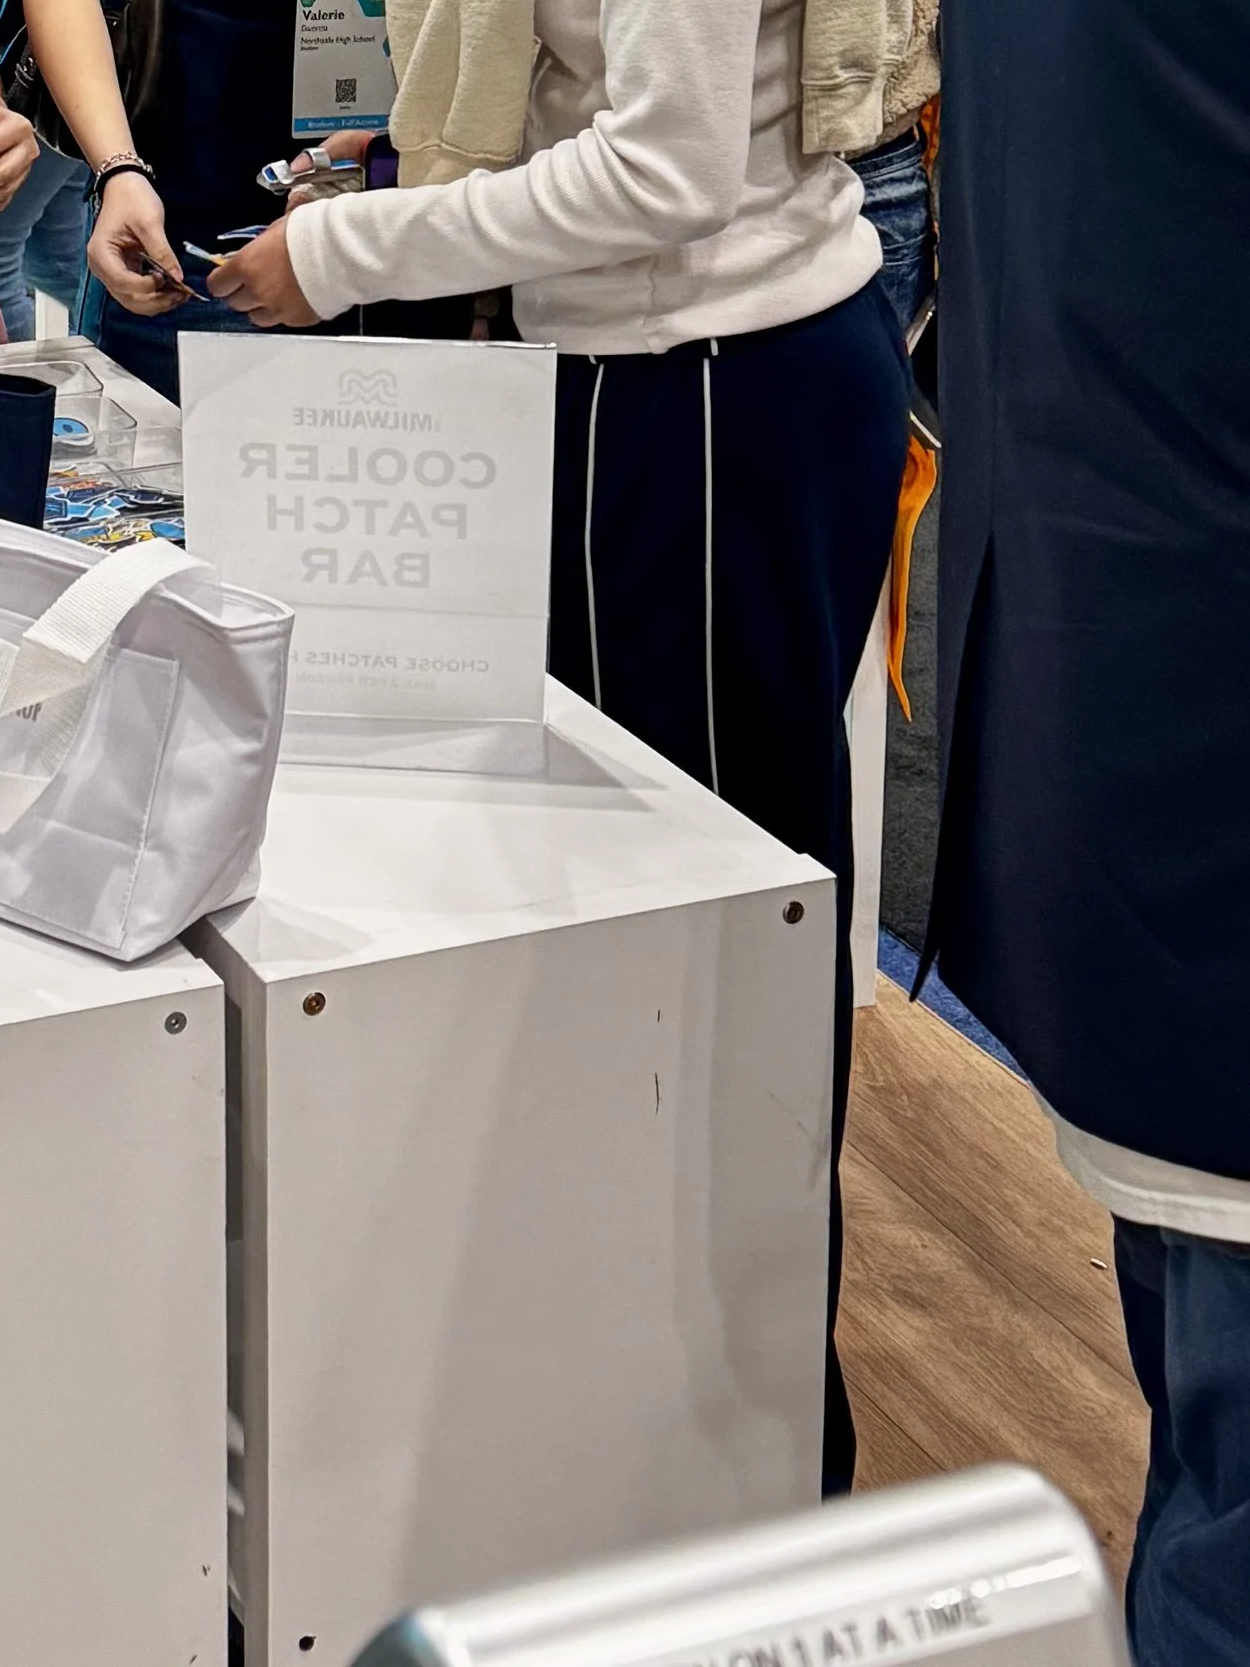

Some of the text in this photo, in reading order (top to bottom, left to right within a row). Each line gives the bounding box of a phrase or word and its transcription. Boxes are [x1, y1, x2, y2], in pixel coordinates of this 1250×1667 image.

[302, 9, 345, 21] Valerie
[822, 1620, 864, 1658] AT
[875, 1615, 900, 1653] A
